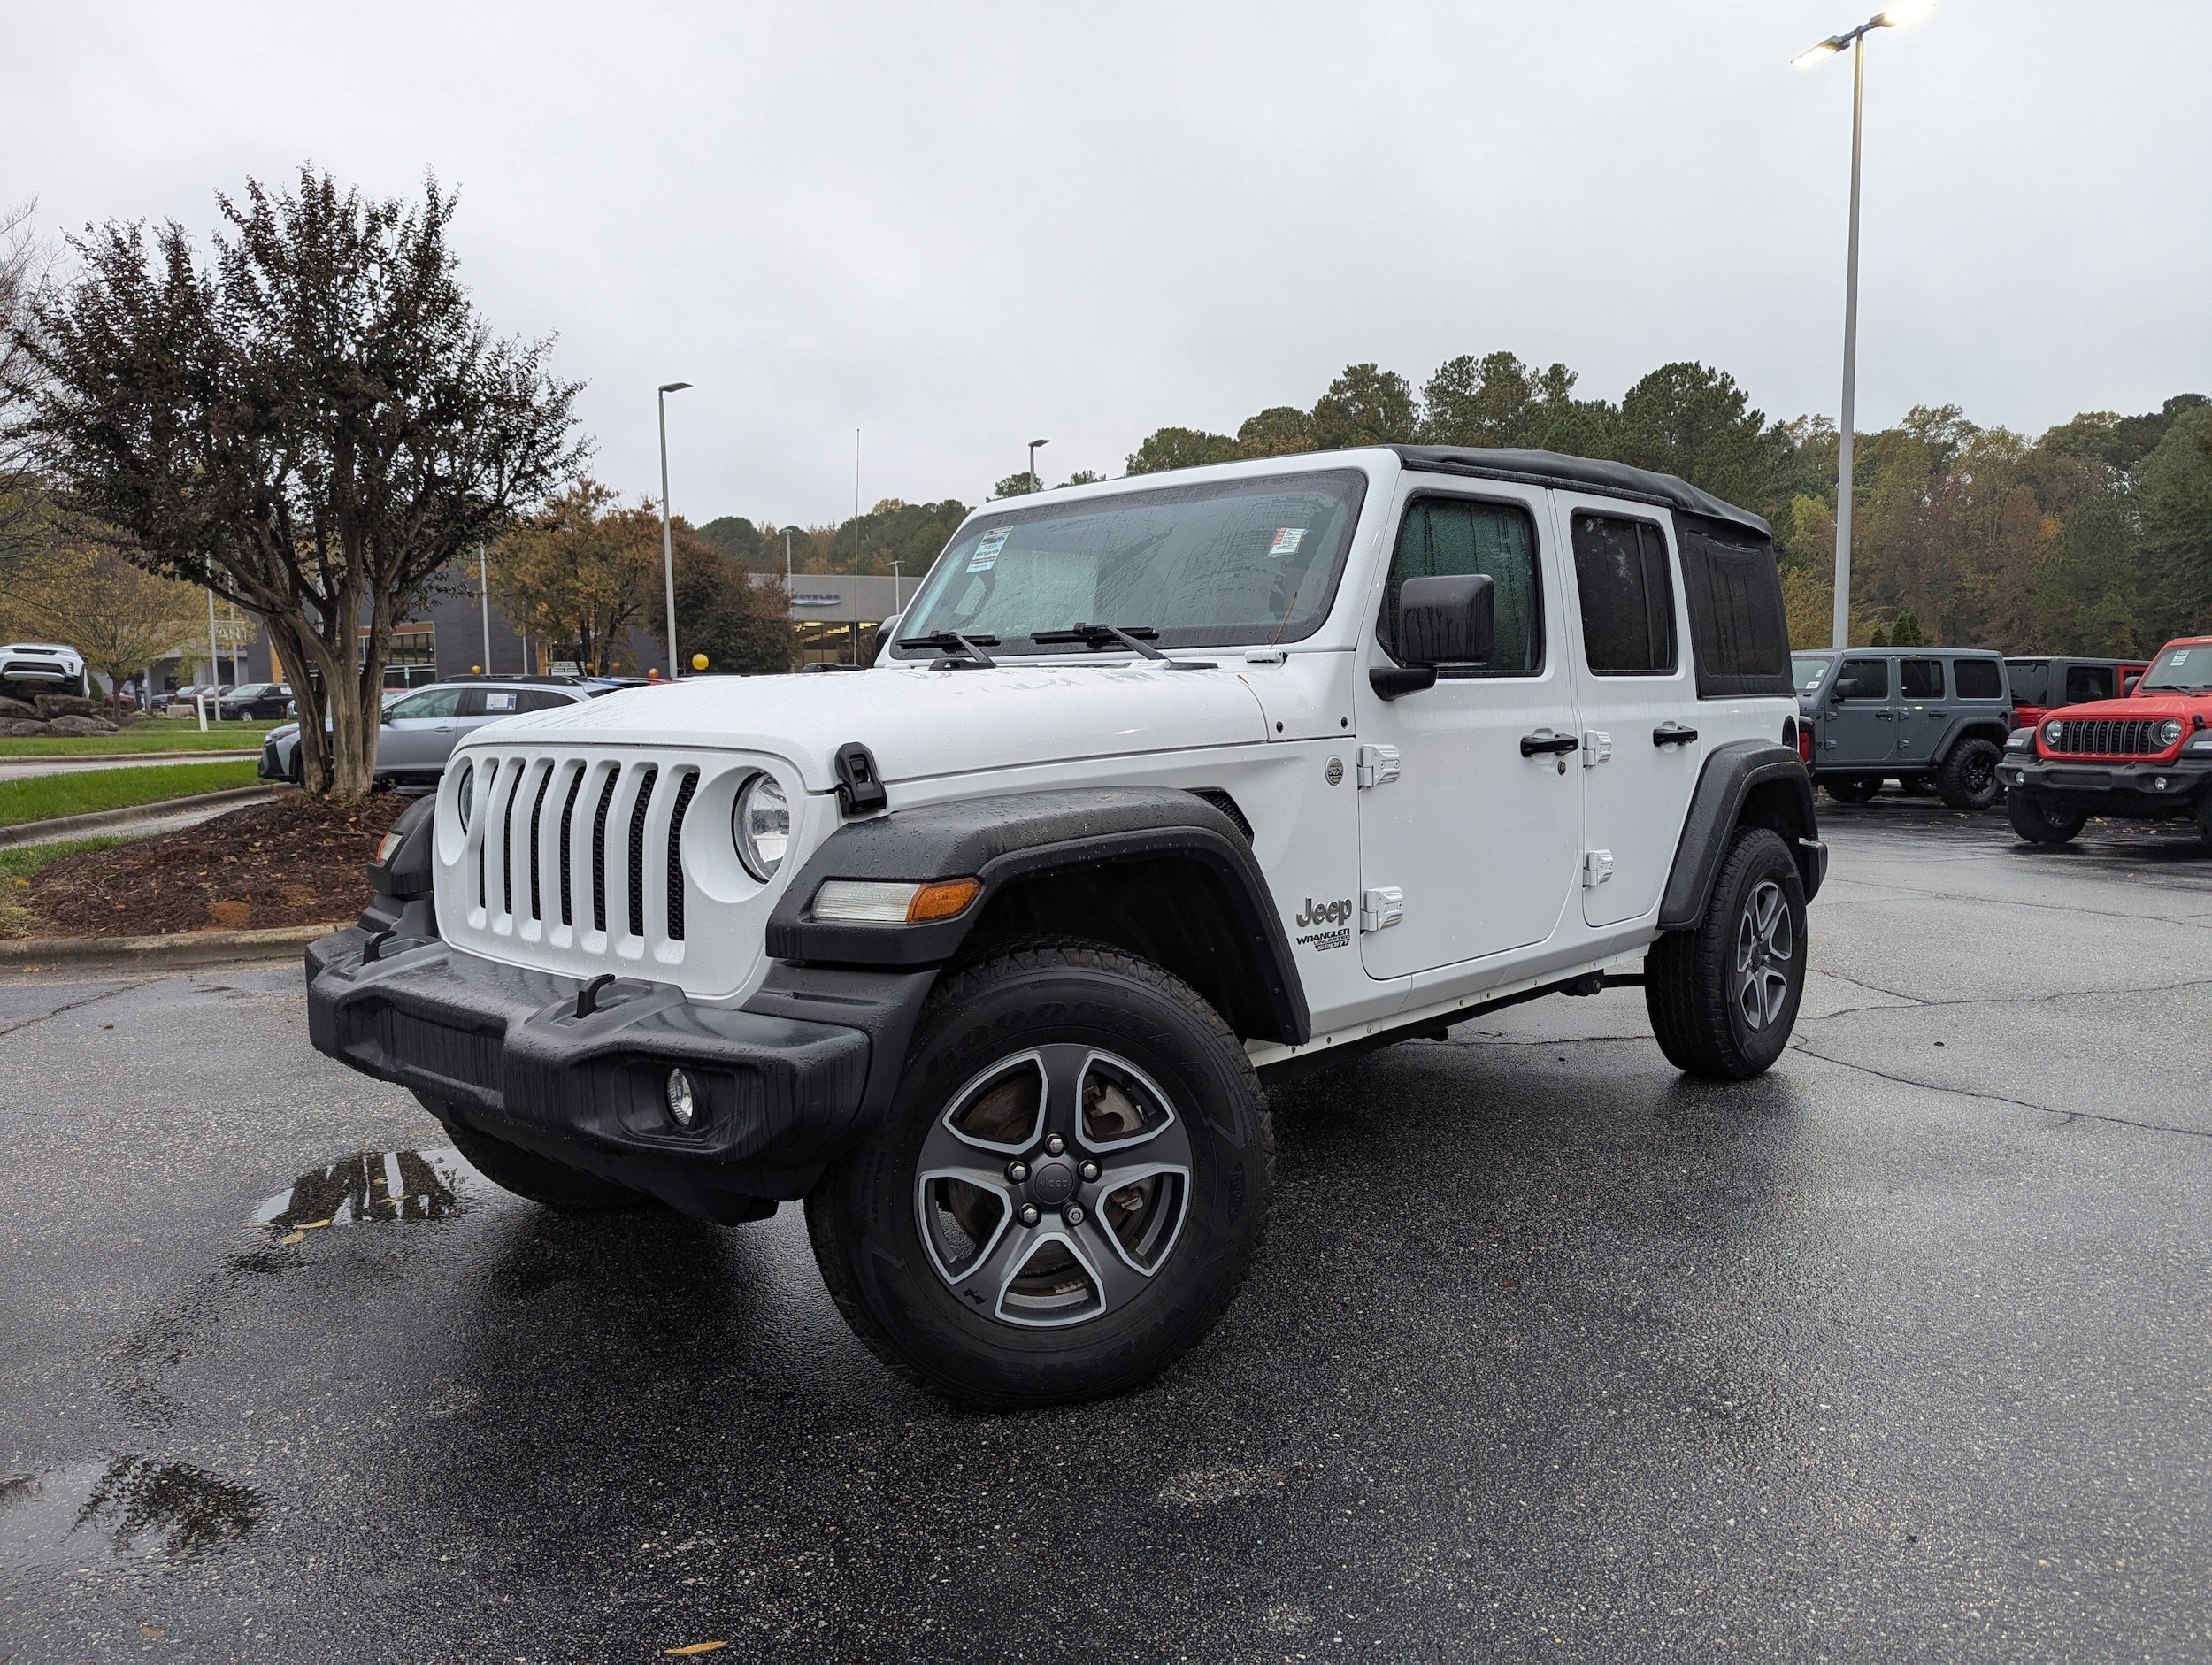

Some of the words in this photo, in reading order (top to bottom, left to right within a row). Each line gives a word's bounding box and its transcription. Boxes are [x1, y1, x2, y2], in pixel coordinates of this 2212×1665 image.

[1296, 897, 1352, 927] Jeep
[1296, 928, 1350, 945] WRANGLER
[1316, 940, 1350, 951] SPORT
[1040, 1177, 1069, 1190] Jeep
